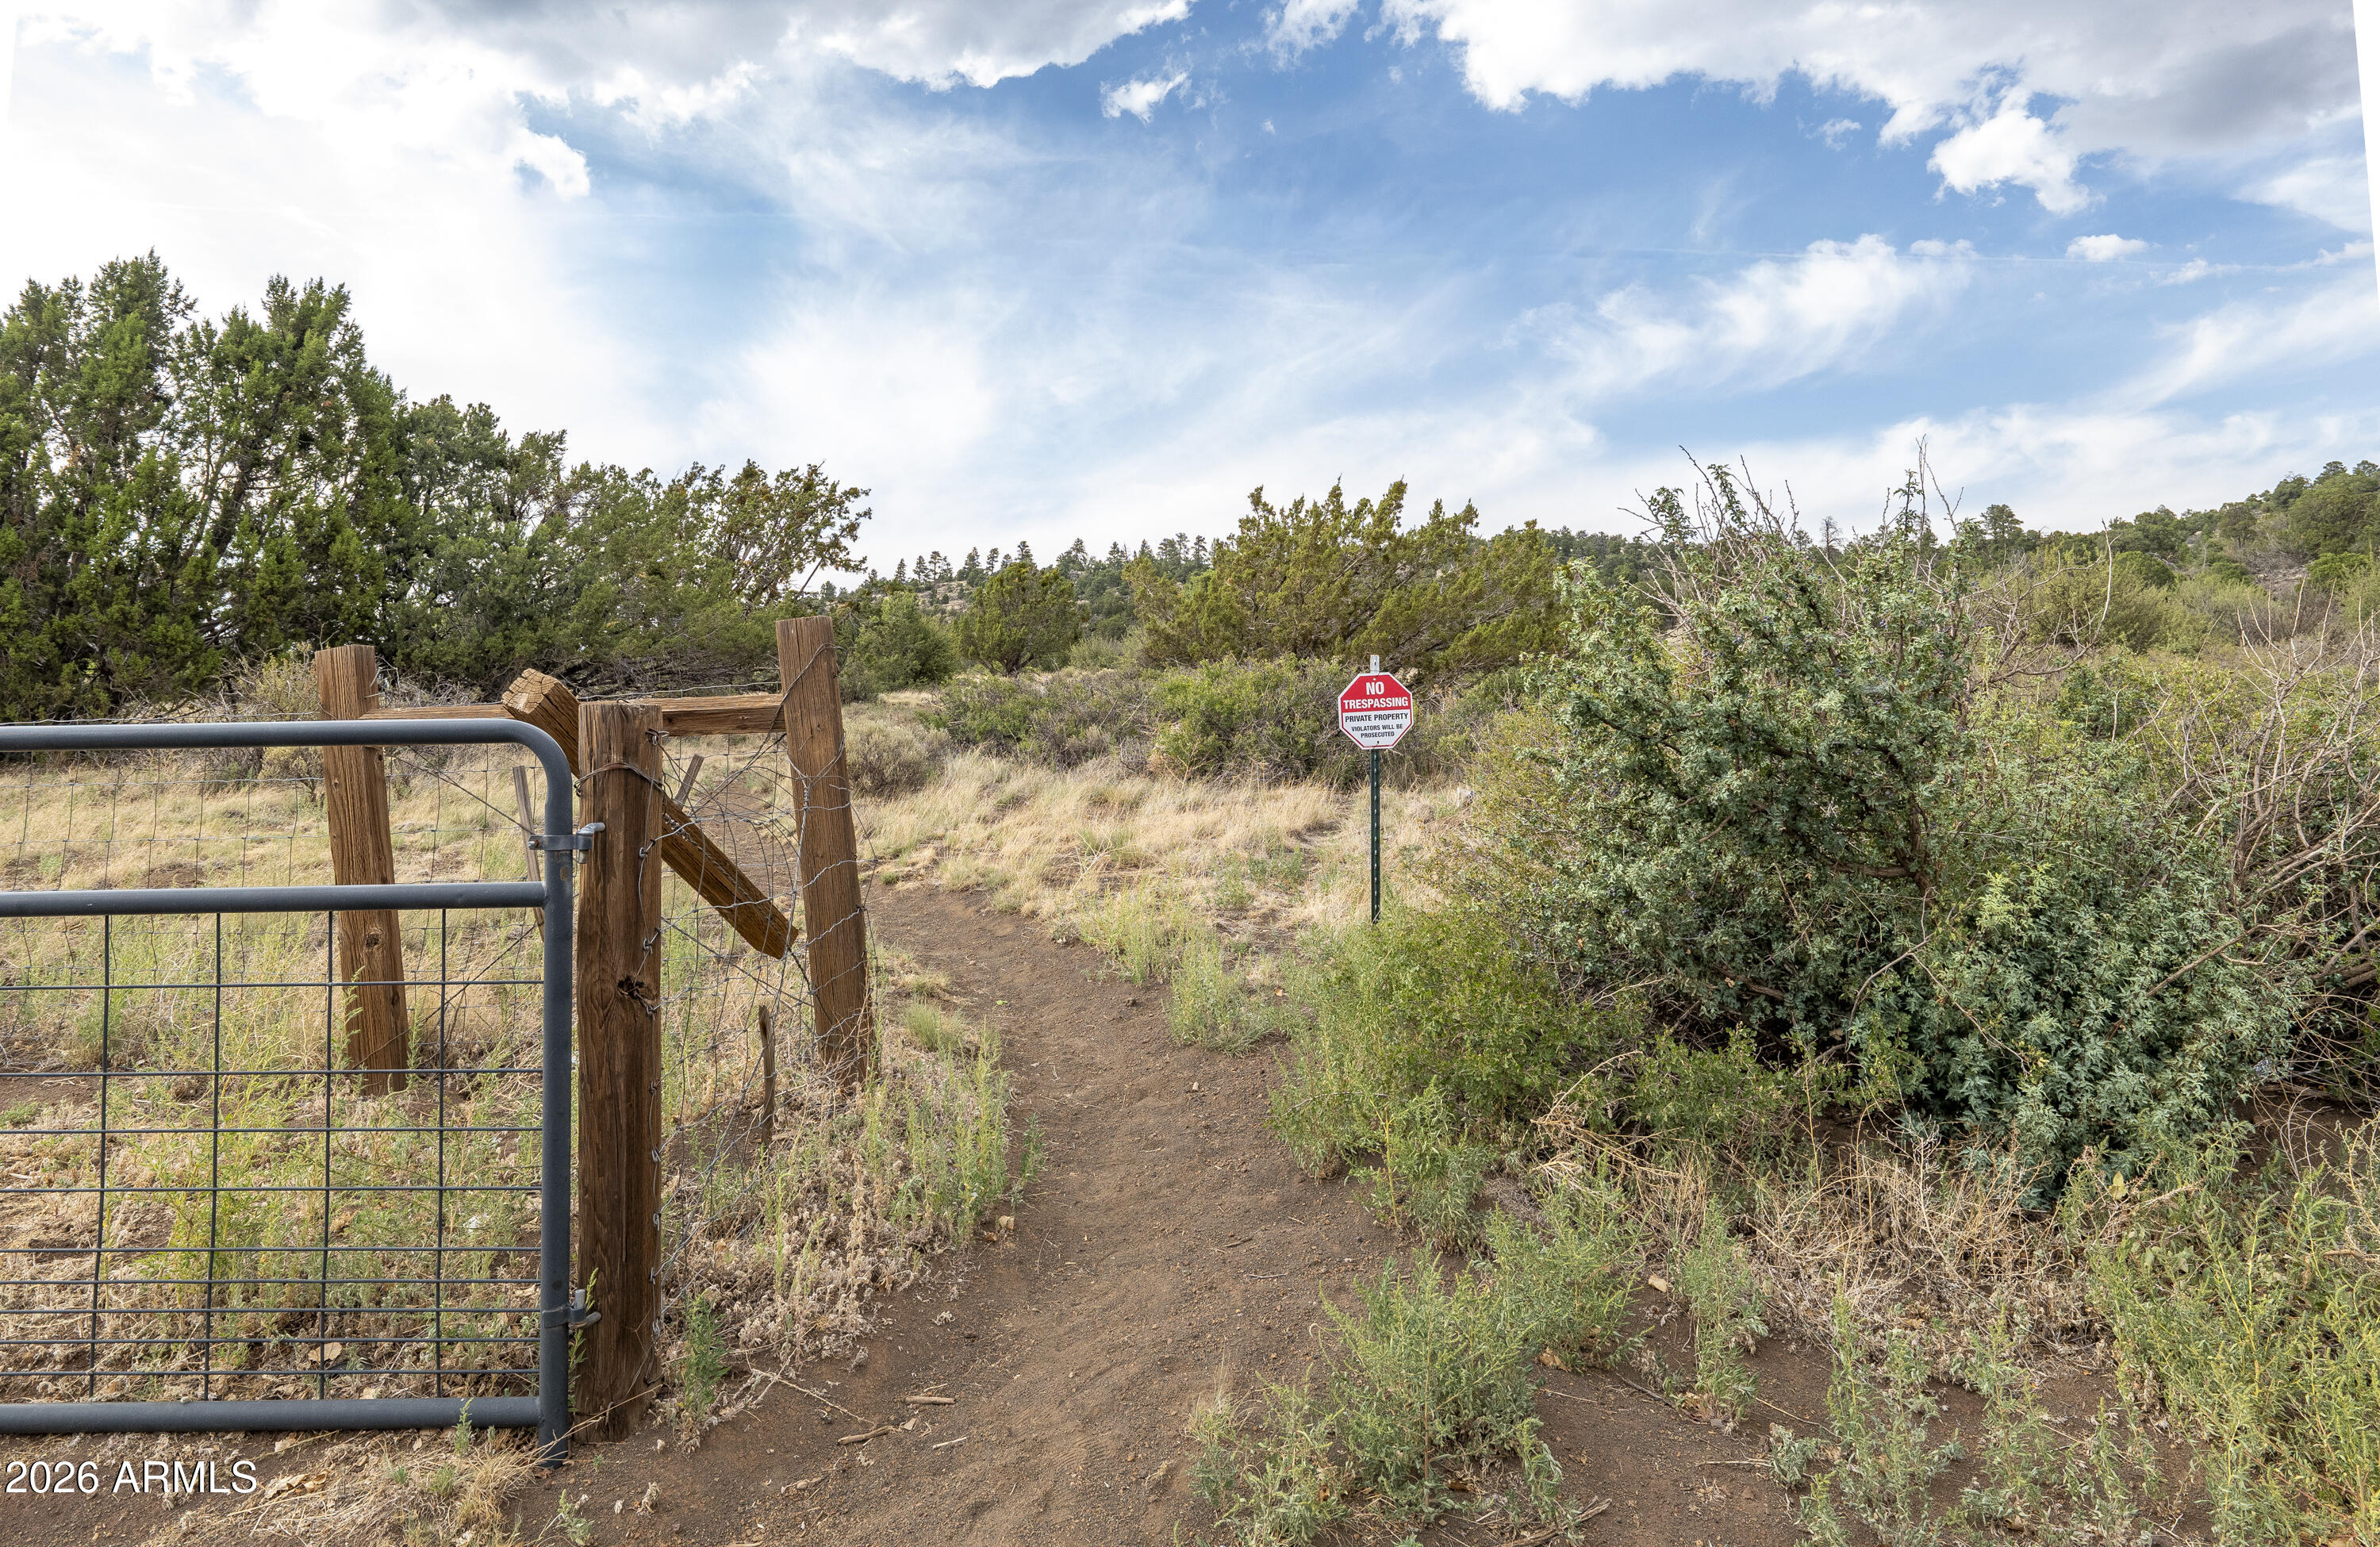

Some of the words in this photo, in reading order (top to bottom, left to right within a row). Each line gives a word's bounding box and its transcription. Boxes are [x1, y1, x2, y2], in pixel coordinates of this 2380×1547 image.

[1365, 681, 1384, 695] NO
[1343, 697, 1408, 709] TRESPASSING
[1345, 714, 1372, 723] PRIVATE
